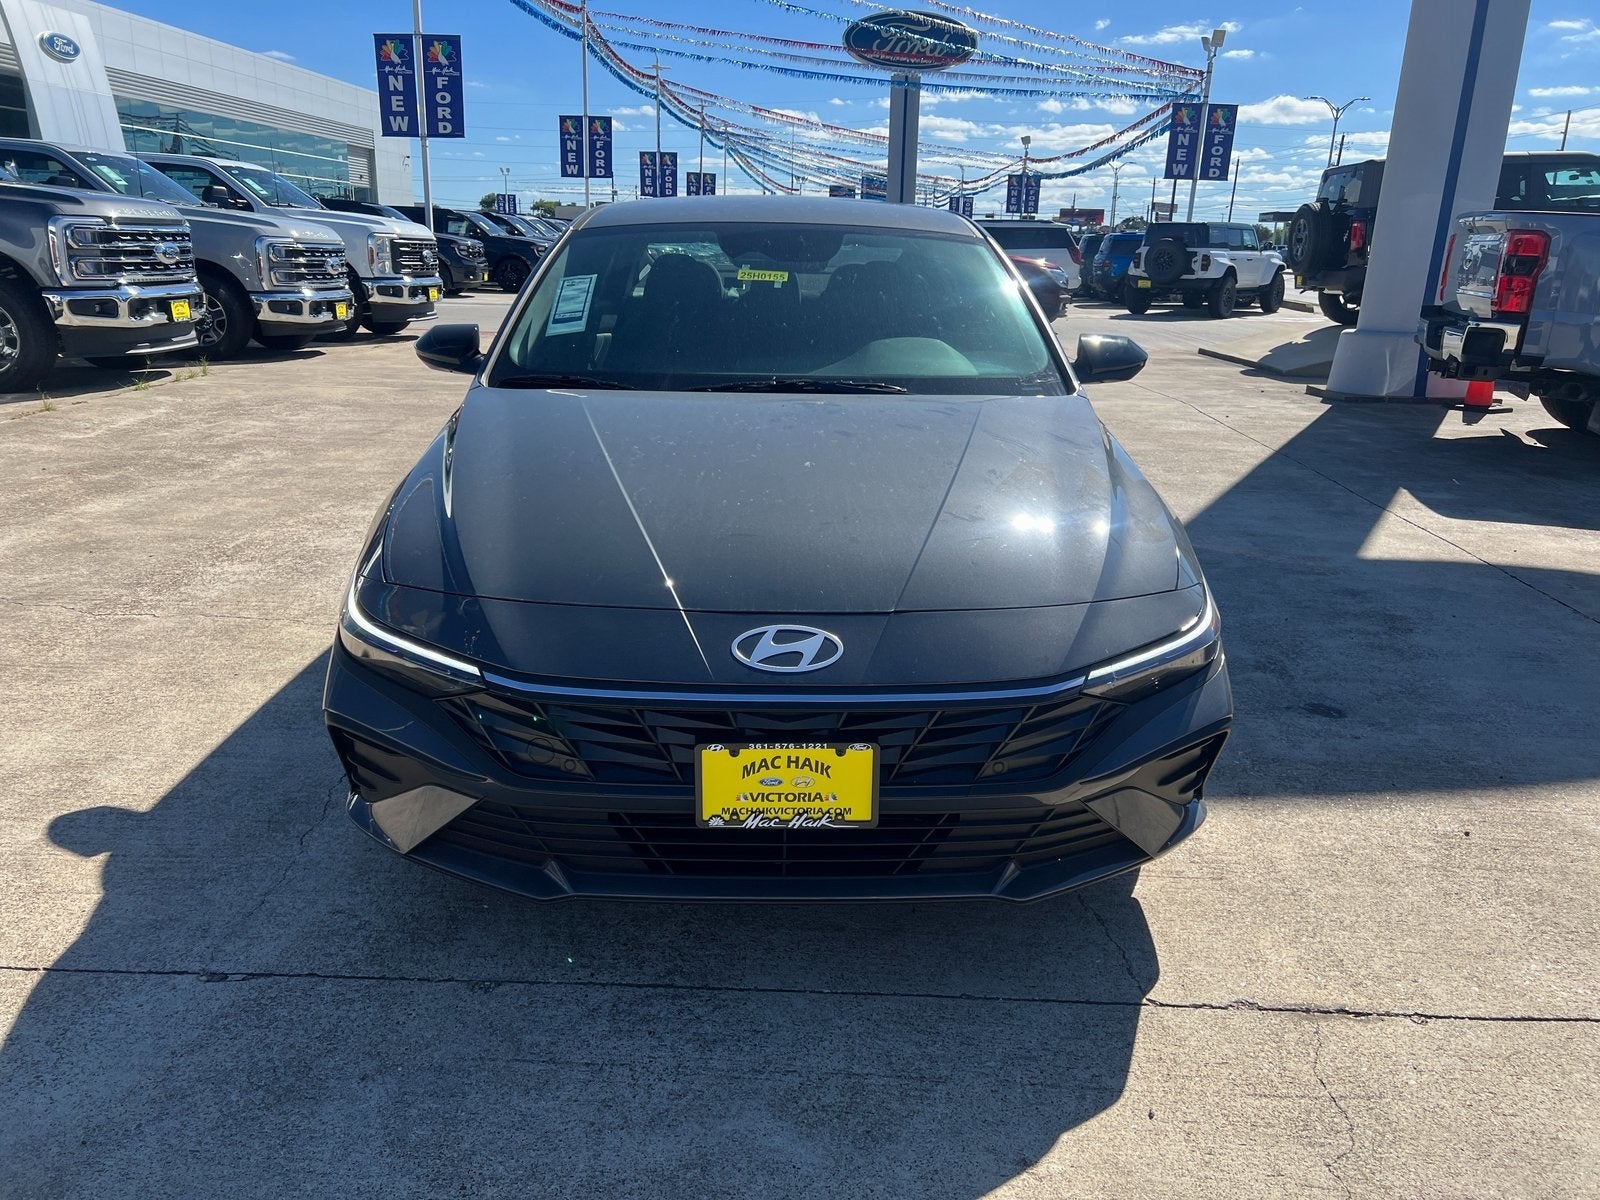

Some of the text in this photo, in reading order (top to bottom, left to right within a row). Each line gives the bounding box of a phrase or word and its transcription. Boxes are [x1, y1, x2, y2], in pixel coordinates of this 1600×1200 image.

[53, 36, 75, 55] Ford
[872, 22, 951, 57] Ford
[388, 75, 409, 132] NEW
[435, 77, 453, 134] FORD
[565, 140, 578, 175] NEW
[595, 141, 606, 176] FORD
[1172, 133, 1190, 176] NEW
[1208, 134, 1225, 178] FORD
[644, 169, 654, 194] NEW
[665, 169, 673, 195] FORD
[1009, 190, 1018, 211] NEW
[1027, 190, 1036, 212] FORD
[740, 271, 786, 280] 25H0155
[742, 755, 831, 780] MAC HAIK
[762, 777, 781, 786] Ford
[748, 792, 824, 803] VICTORIA
[742, 813, 836, 829] Mac Haik
